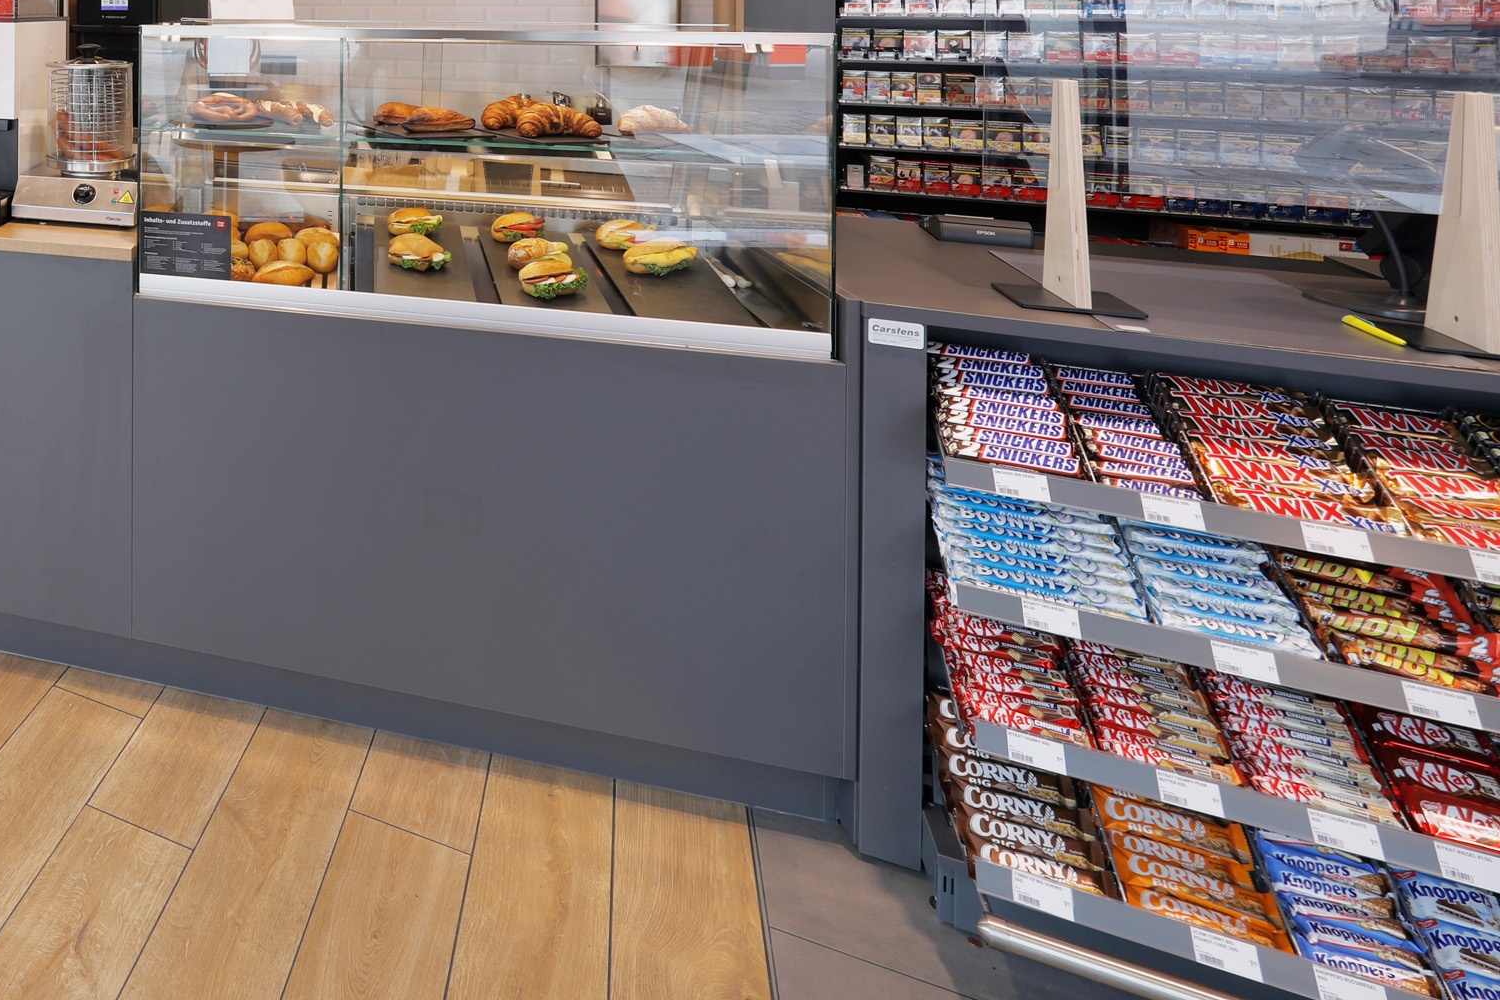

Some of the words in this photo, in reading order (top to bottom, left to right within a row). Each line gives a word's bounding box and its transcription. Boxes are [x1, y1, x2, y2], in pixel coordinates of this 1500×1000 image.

[144, 216, 165, 224] Inhalts-
[177, 219, 211, 227] Zusatzstoffe
[872, 324, 920, 337] Carstens
[948, 344, 1030, 362] SNICKERS
[961, 358, 1043, 378] SNICKERS
[963, 371, 1048, 392] SNICKERS
[976, 400, 1064, 425] SNICKERS
[1178, 410, 1282, 439] TWIX
[1336, 403, 1455, 434] TWIX
[979, 429, 1072, 457] SNICKERS
[1187, 430, 1293, 459] TWIX
[986, 445, 1078, 473] SNICKERS
[1207, 453, 1317, 485] TWIX
[1234, 488, 1347, 521] TWIX
[1346, 516, 1397, 533] Xtra
[976, 565, 1073, 593] BOUNTY
[1295, 559, 1374, 584] LION
[1184, 615, 1284, 644] BOUNTY
[1332, 614, 1419, 641] LION
[966, 653, 1012, 674] KitKat
[986, 707, 1032, 729] KitKat
[1034, 719, 1070, 735] CHUNKY
[1391, 718, 1448, 746] KitKat
[949, 753, 1028, 784] CORNY
[1413, 759, 1472, 790] KitKat
[964, 784, 1045, 818] CORNY
[1105, 796, 1195, 833] CORNY
[1128, 822, 1154, 835] BIG
[1276, 852, 1350, 878] Knoppers
[1283, 872, 1358, 899] Knoppers
[1408, 880, 1492, 907] Knoppers
